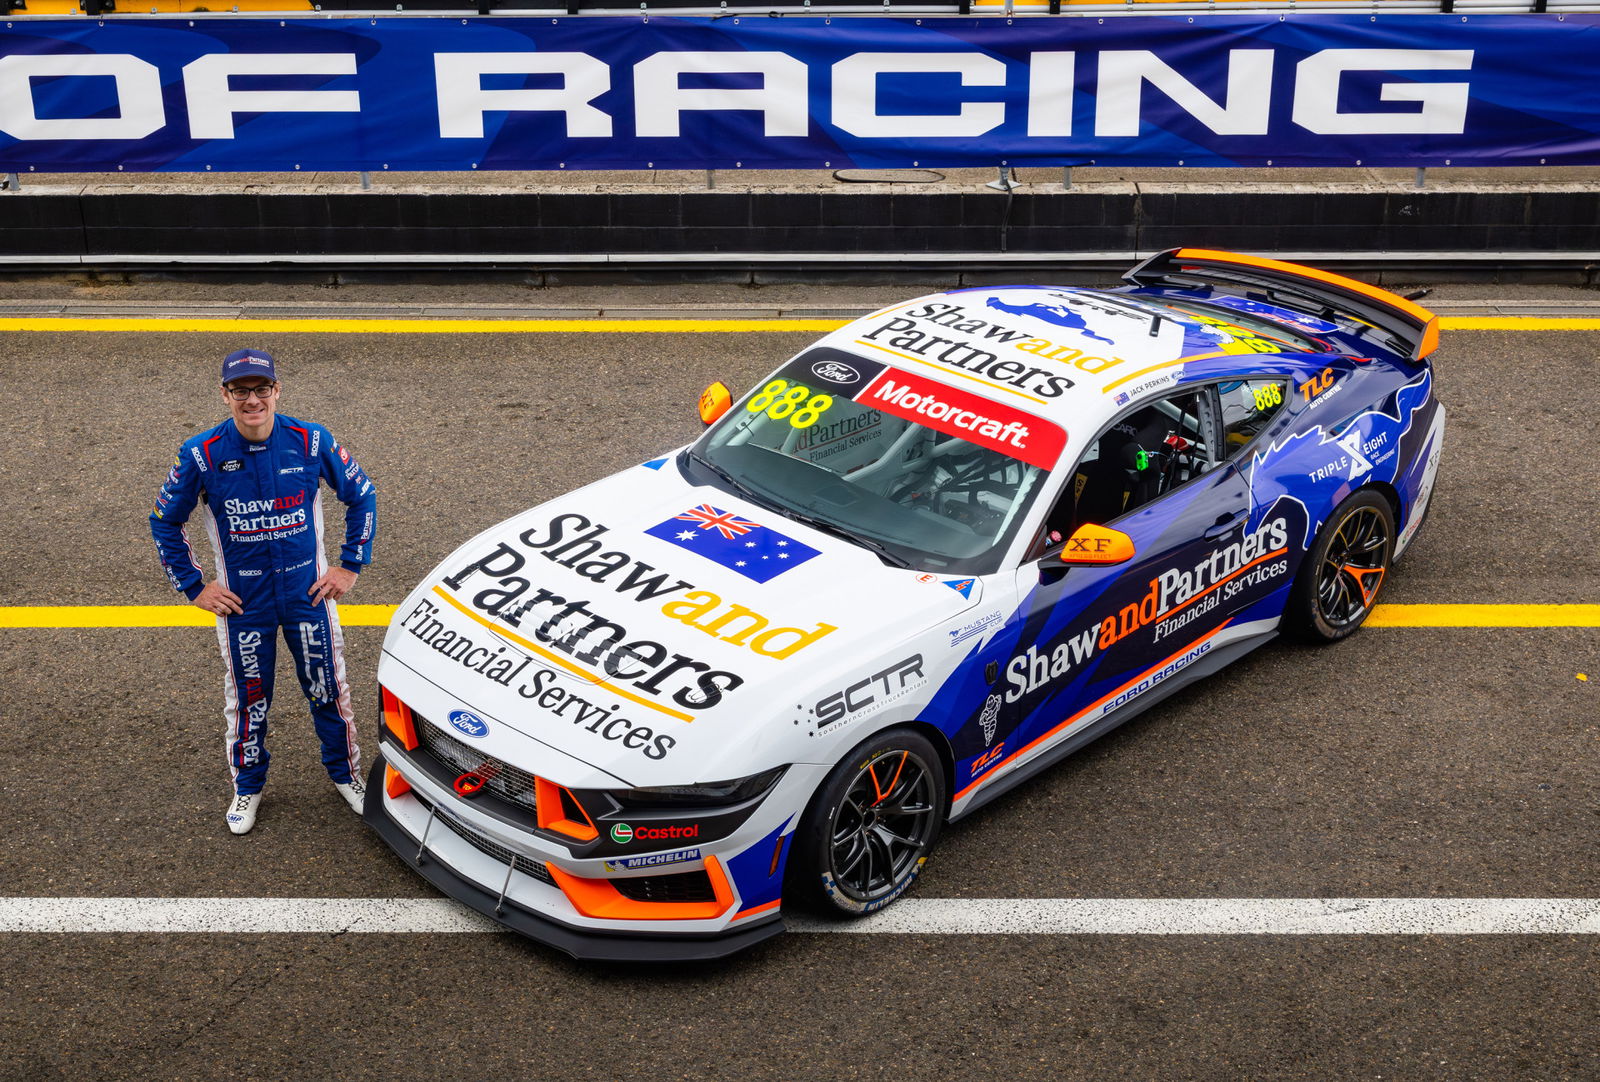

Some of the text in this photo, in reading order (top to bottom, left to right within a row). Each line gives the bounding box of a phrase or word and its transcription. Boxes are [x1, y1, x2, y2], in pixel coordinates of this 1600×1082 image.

[0, 48, 1474, 140] OF RACING
[862, 316, 1076, 399] Partners
[1130, 384, 1145, 397] JACK
[1144, 375, 1170, 389] PERKINS
[1253, 382, 1282, 411] 888
[1299, 367, 1334, 403] TLC
[746, 379, 833, 429] 888
[1309, 396, 1324, 410] AUTO
[809, 429, 882, 462] Financial Services
[1362, 431, 1388, 455] EIGHT
[1308, 455, 1348, 483] TRIPLE
[227, 508, 306, 532] Partners
[230, 524, 308, 542] Financial Services
[1069, 538, 1112, 552] XF
[920, 574, 933, 582] E
[1153, 560, 1288, 644] Financial Services
[442, 542, 744, 710] Partners
[400, 598, 677, 761] Financial Services
[815, 653, 925, 729] SCTR
[1103, 641, 1211, 715] FORD RACING
[971, 742, 1005, 773] TLC
[634, 824, 699, 840] Castrol
[627, 849, 698, 867] MICHELIN
